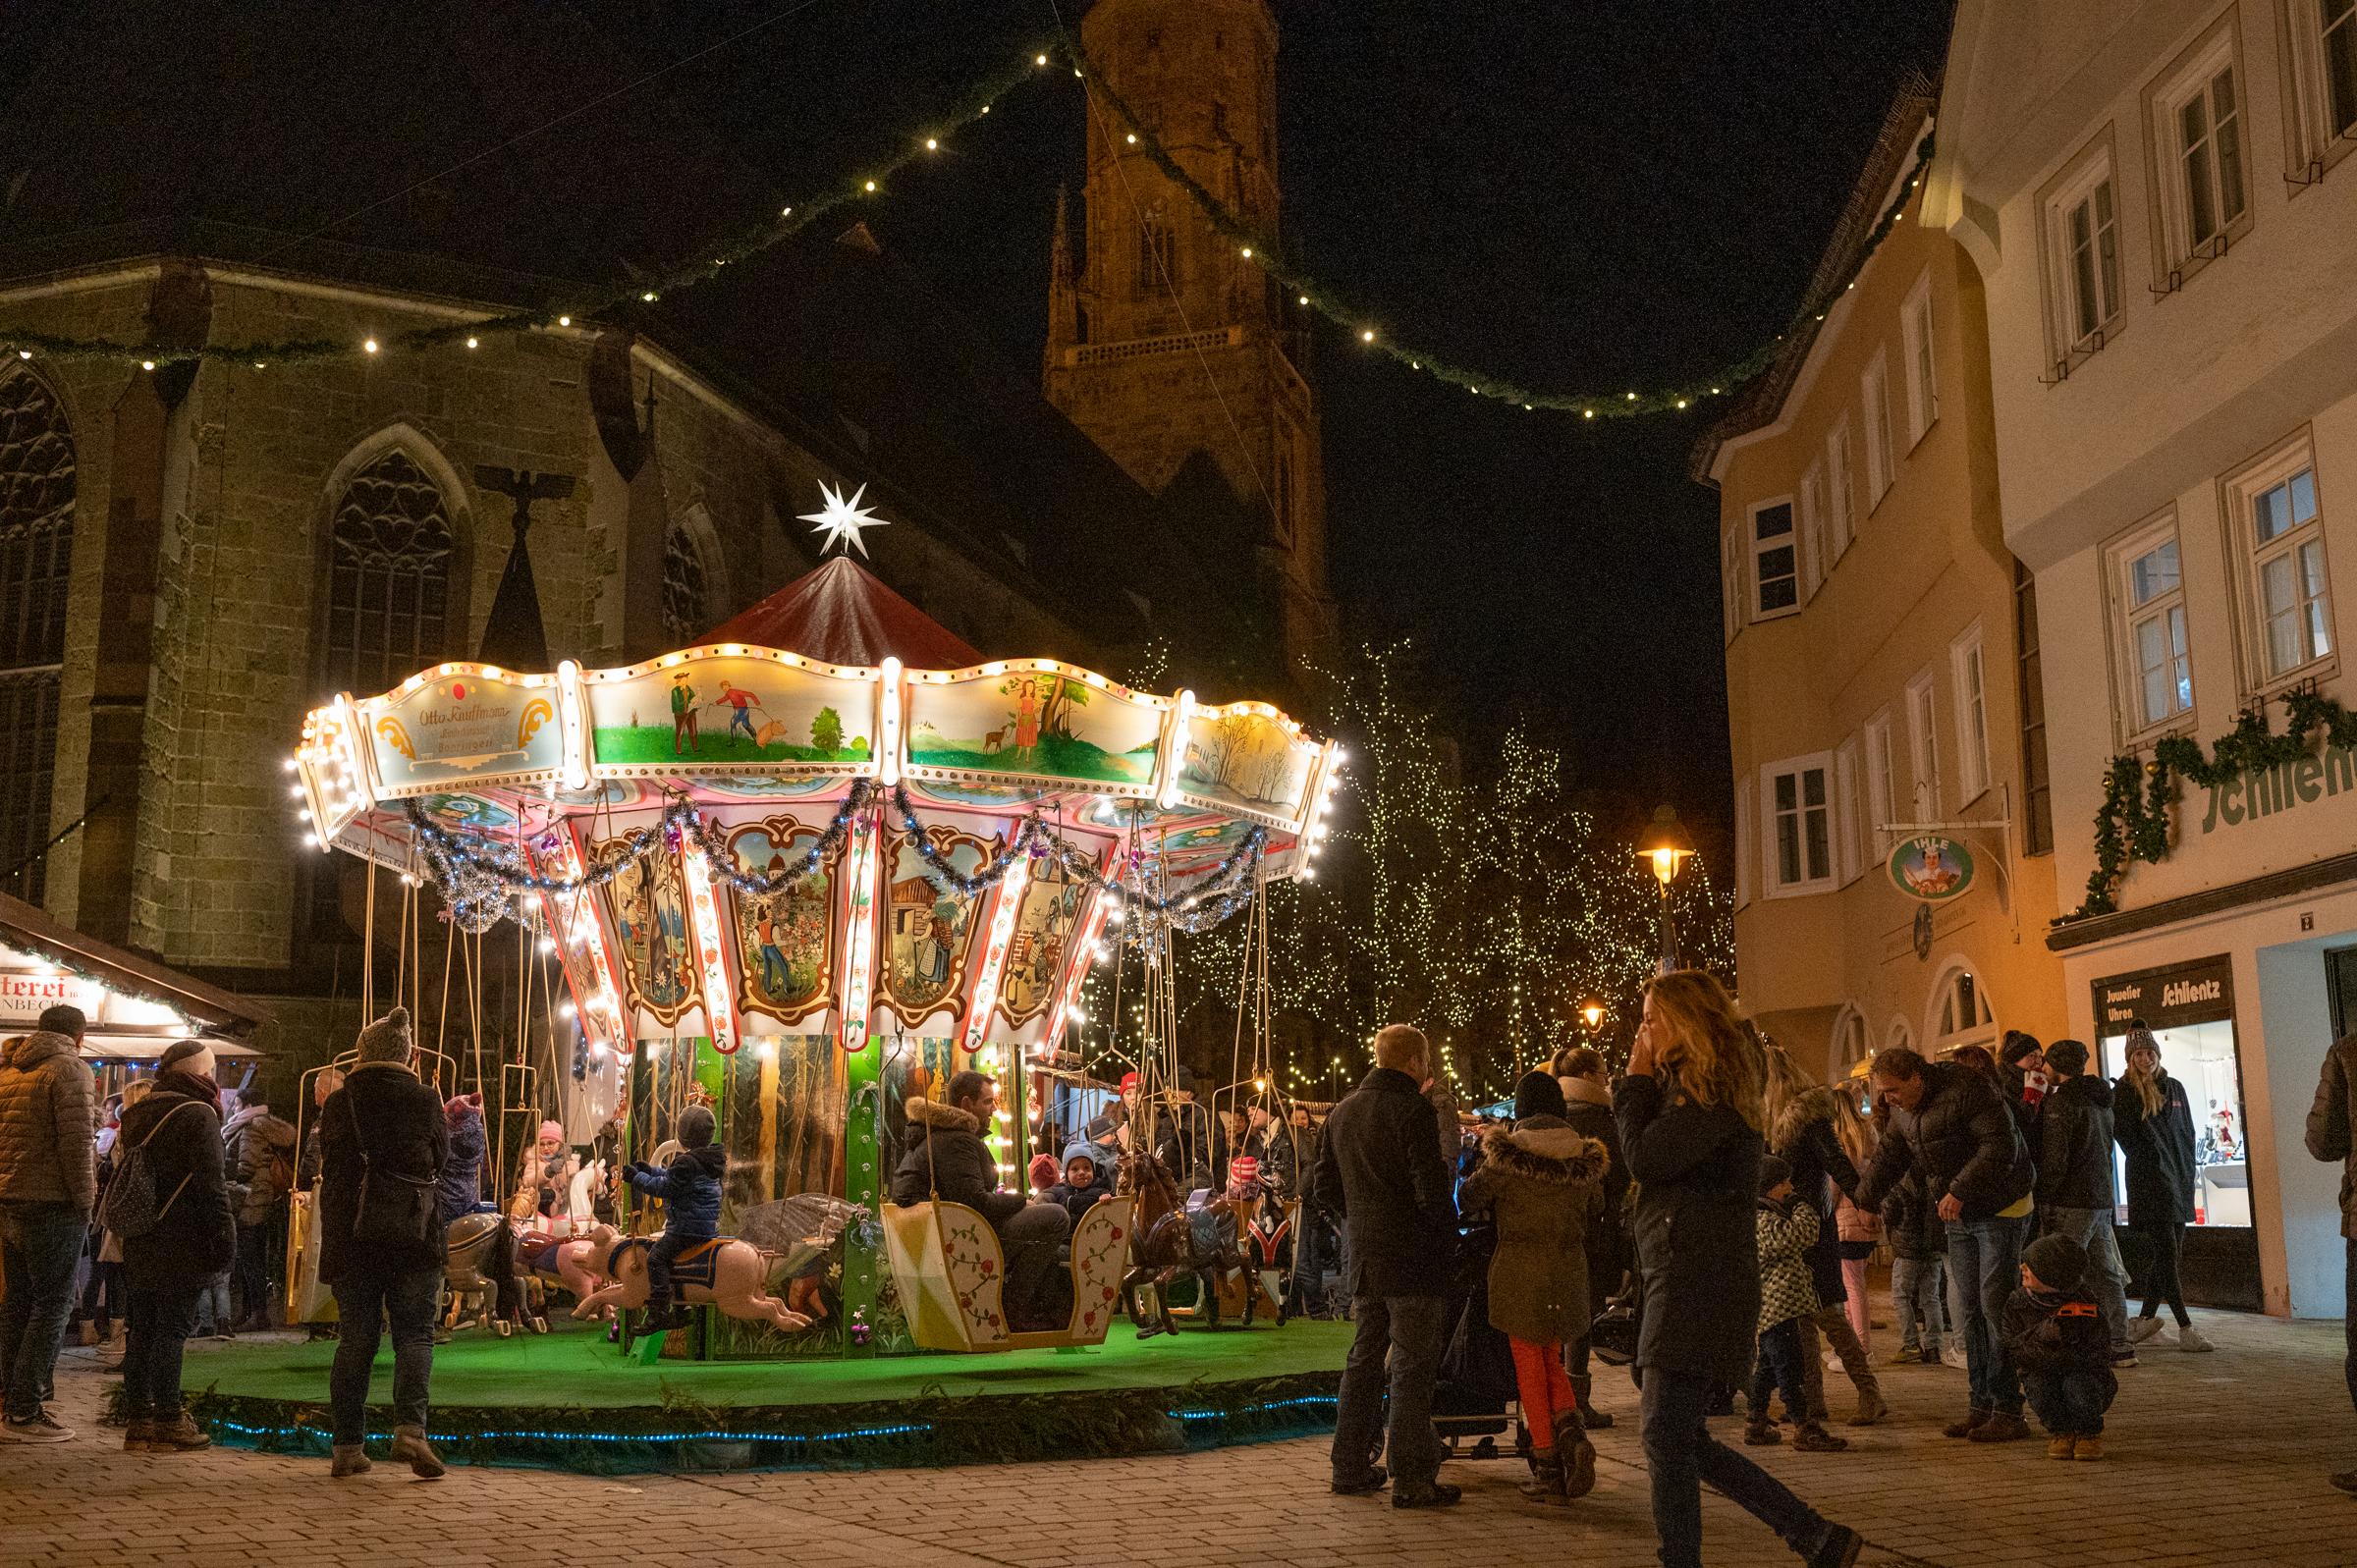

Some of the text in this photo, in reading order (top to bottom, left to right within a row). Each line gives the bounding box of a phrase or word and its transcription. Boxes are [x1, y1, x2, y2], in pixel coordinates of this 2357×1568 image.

[419, 709, 447, 727] Otto
[2202, 745, 2357, 835] Schlien
[1913, 838, 1950, 850] IHLE
[2107, 985, 2142, 1003] Juwelier
[2162, 979, 2220, 1007] Schlientz
[2108, 1007, 2134, 1021] Uhren
